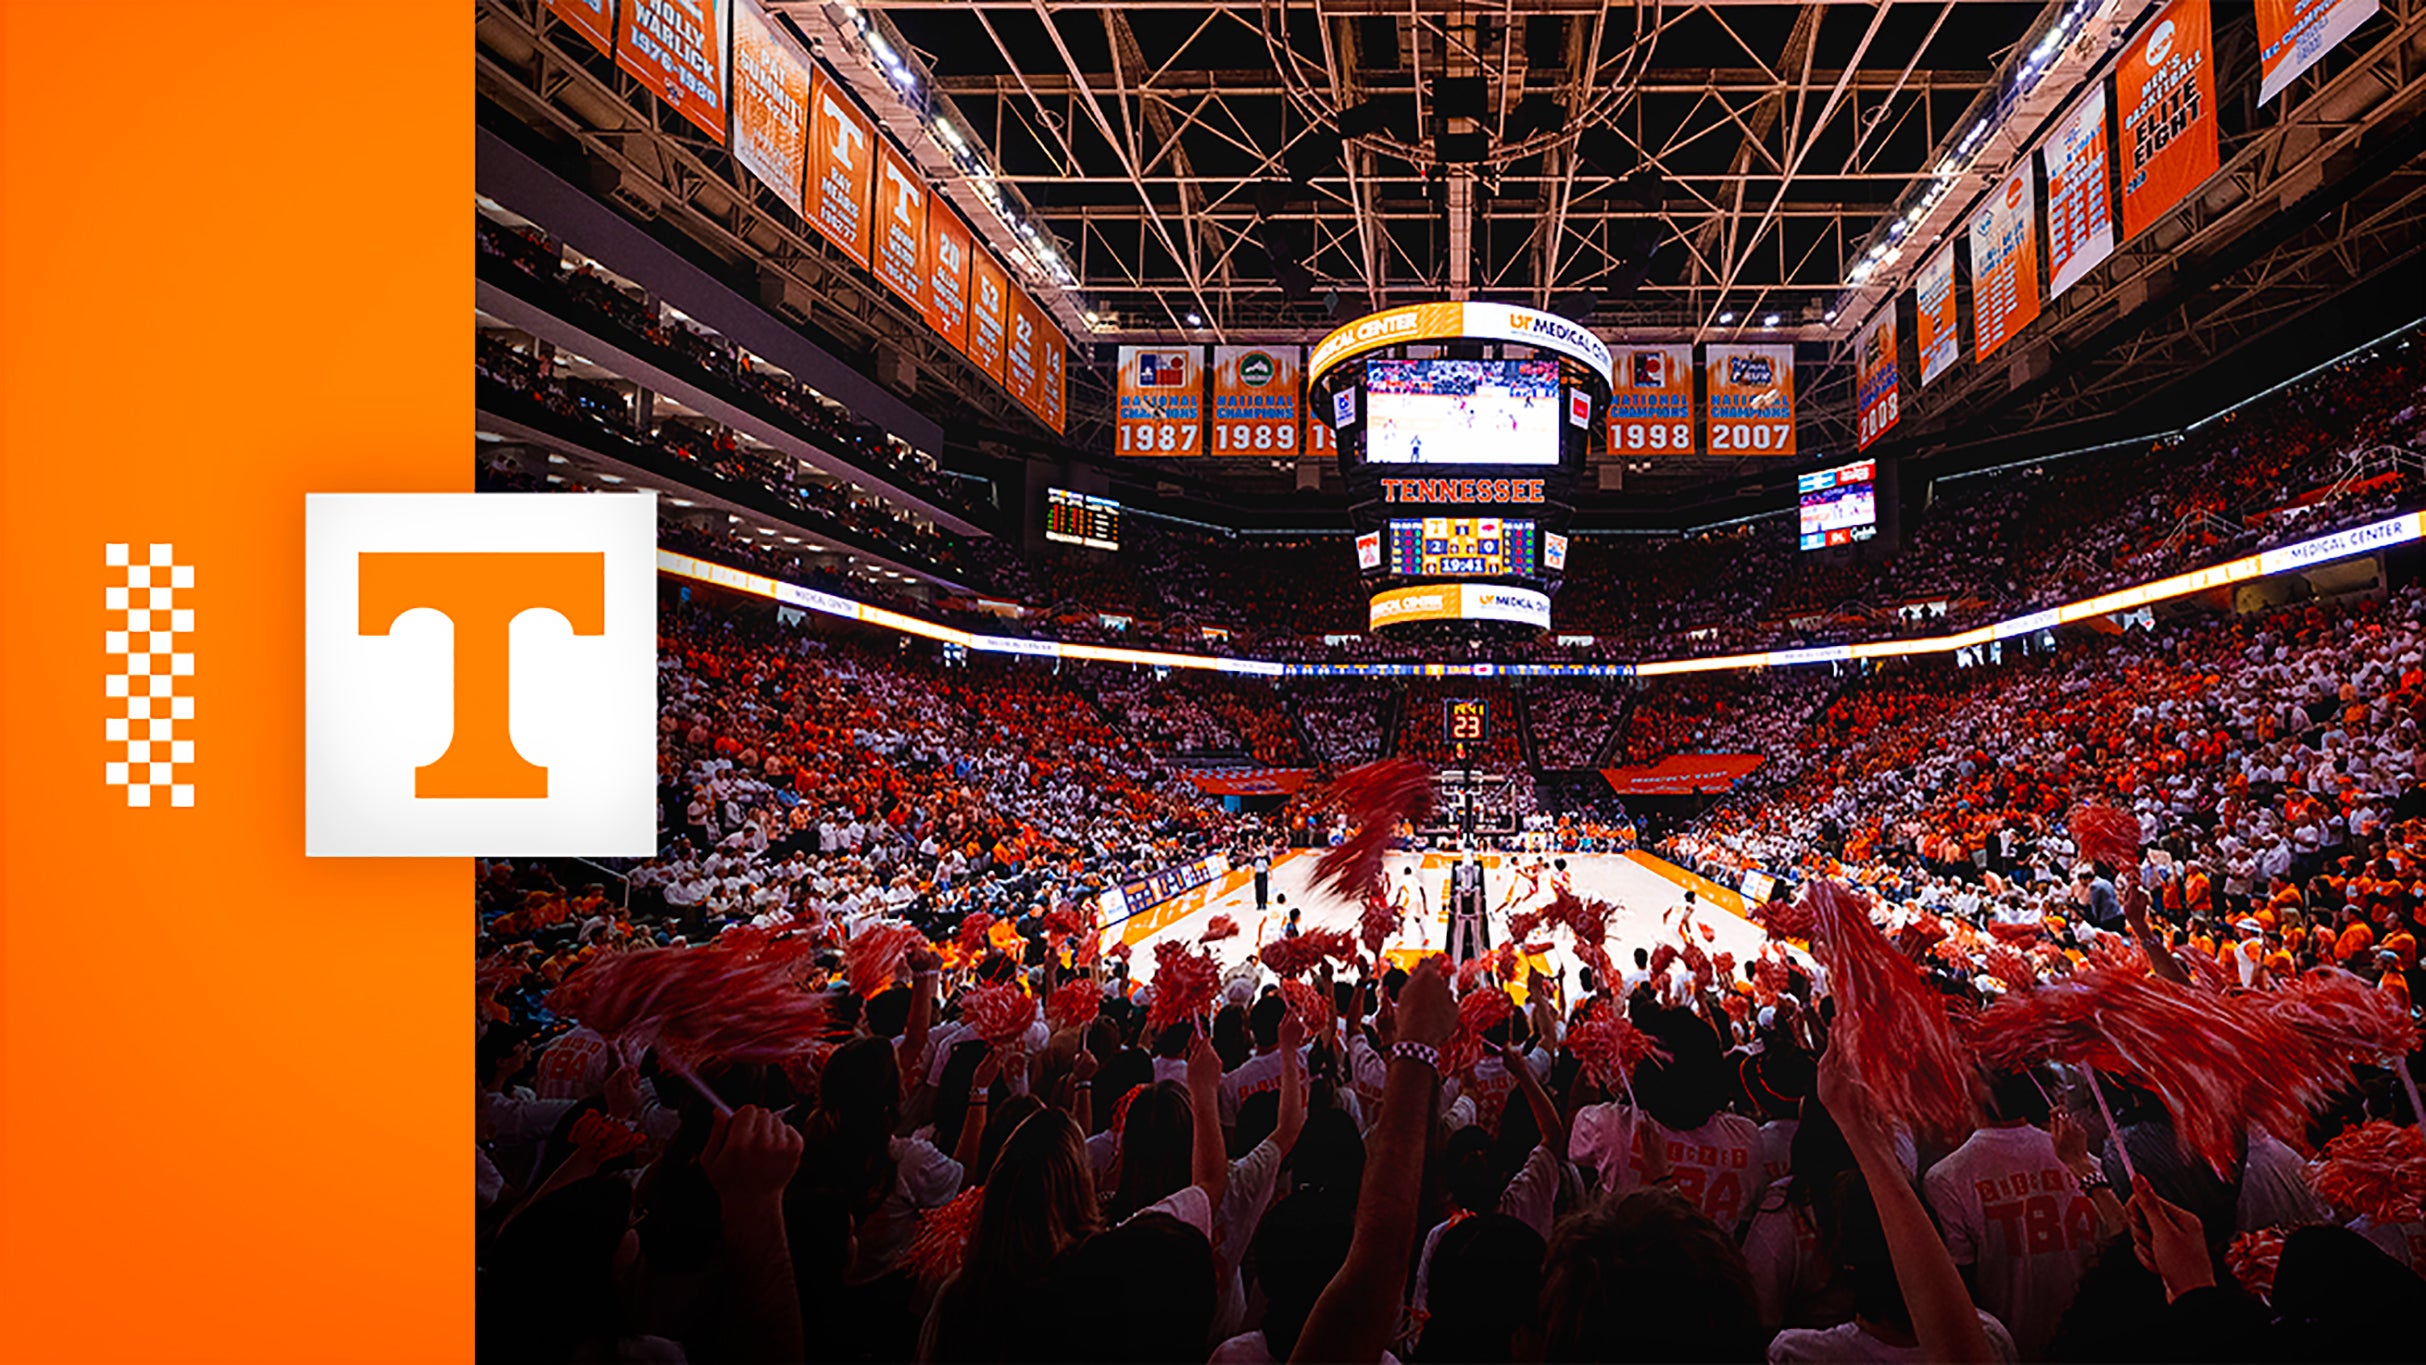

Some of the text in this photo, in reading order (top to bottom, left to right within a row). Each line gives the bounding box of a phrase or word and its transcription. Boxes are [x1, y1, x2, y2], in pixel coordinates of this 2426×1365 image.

[651, 0, 704, 49] HOLLY
[635, 0, 714, 84] WARLICK
[631, 25, 717, 108] 1976-1980
[761, 49, 785, 86] PAT
[2142, 53, 2180, 98] MEN'S
[740, 49, 802, 126] SUMMITT
[2125, 50, 2201, 130] BASKETBALL
[2136, 74, 2196, 147] ELITE
[823, 93, 864, 172] T
[2134, 94, 2201, 172] EIGHT
[831, 166, 852, 194] RAY
[887, 160, 919, 227] T
[940, 232, 960, 274] 20
[1016, 313, 1033, 347] 22
[1357, 313, 1418, 340] CENTER
[1533, 318, 1590, 352] MEDICAL
[1045, 342, 1060, 373] 14
[1217, 395, 1294, 406] NATIONAL
[1217, 407, 1294, 418] CHAMPIONS
[1610, 406, 1688, 418] CHAMPIONS
[1611, 394, 1688, 405] NATIONAL
[1711, 407, 1790, 418] CHAMPIONS
[1860, 391, 1897, 445] 2008
[1121, 425, 1198, 450] 1987
[1216, 425, 1294, 449] 1989
[1610, 424, 1690, 449] 1998
[1712, 425, 1790, 449] 2007
[1381, 478, 1545, 503] TENNESSEE
[1430, 542, 1442, 553] 2
[1484, 542, 1495, 553] 0
[2291, 521, 2403, 560] MEDICAL CENTER
[1442, 558, 1484, 573] 19:41
[1453, 716, 1480, 739] 23
[1631, 774, 1691, 783] ROCKY
[1984, 1195, 2098, 1257] TBA
